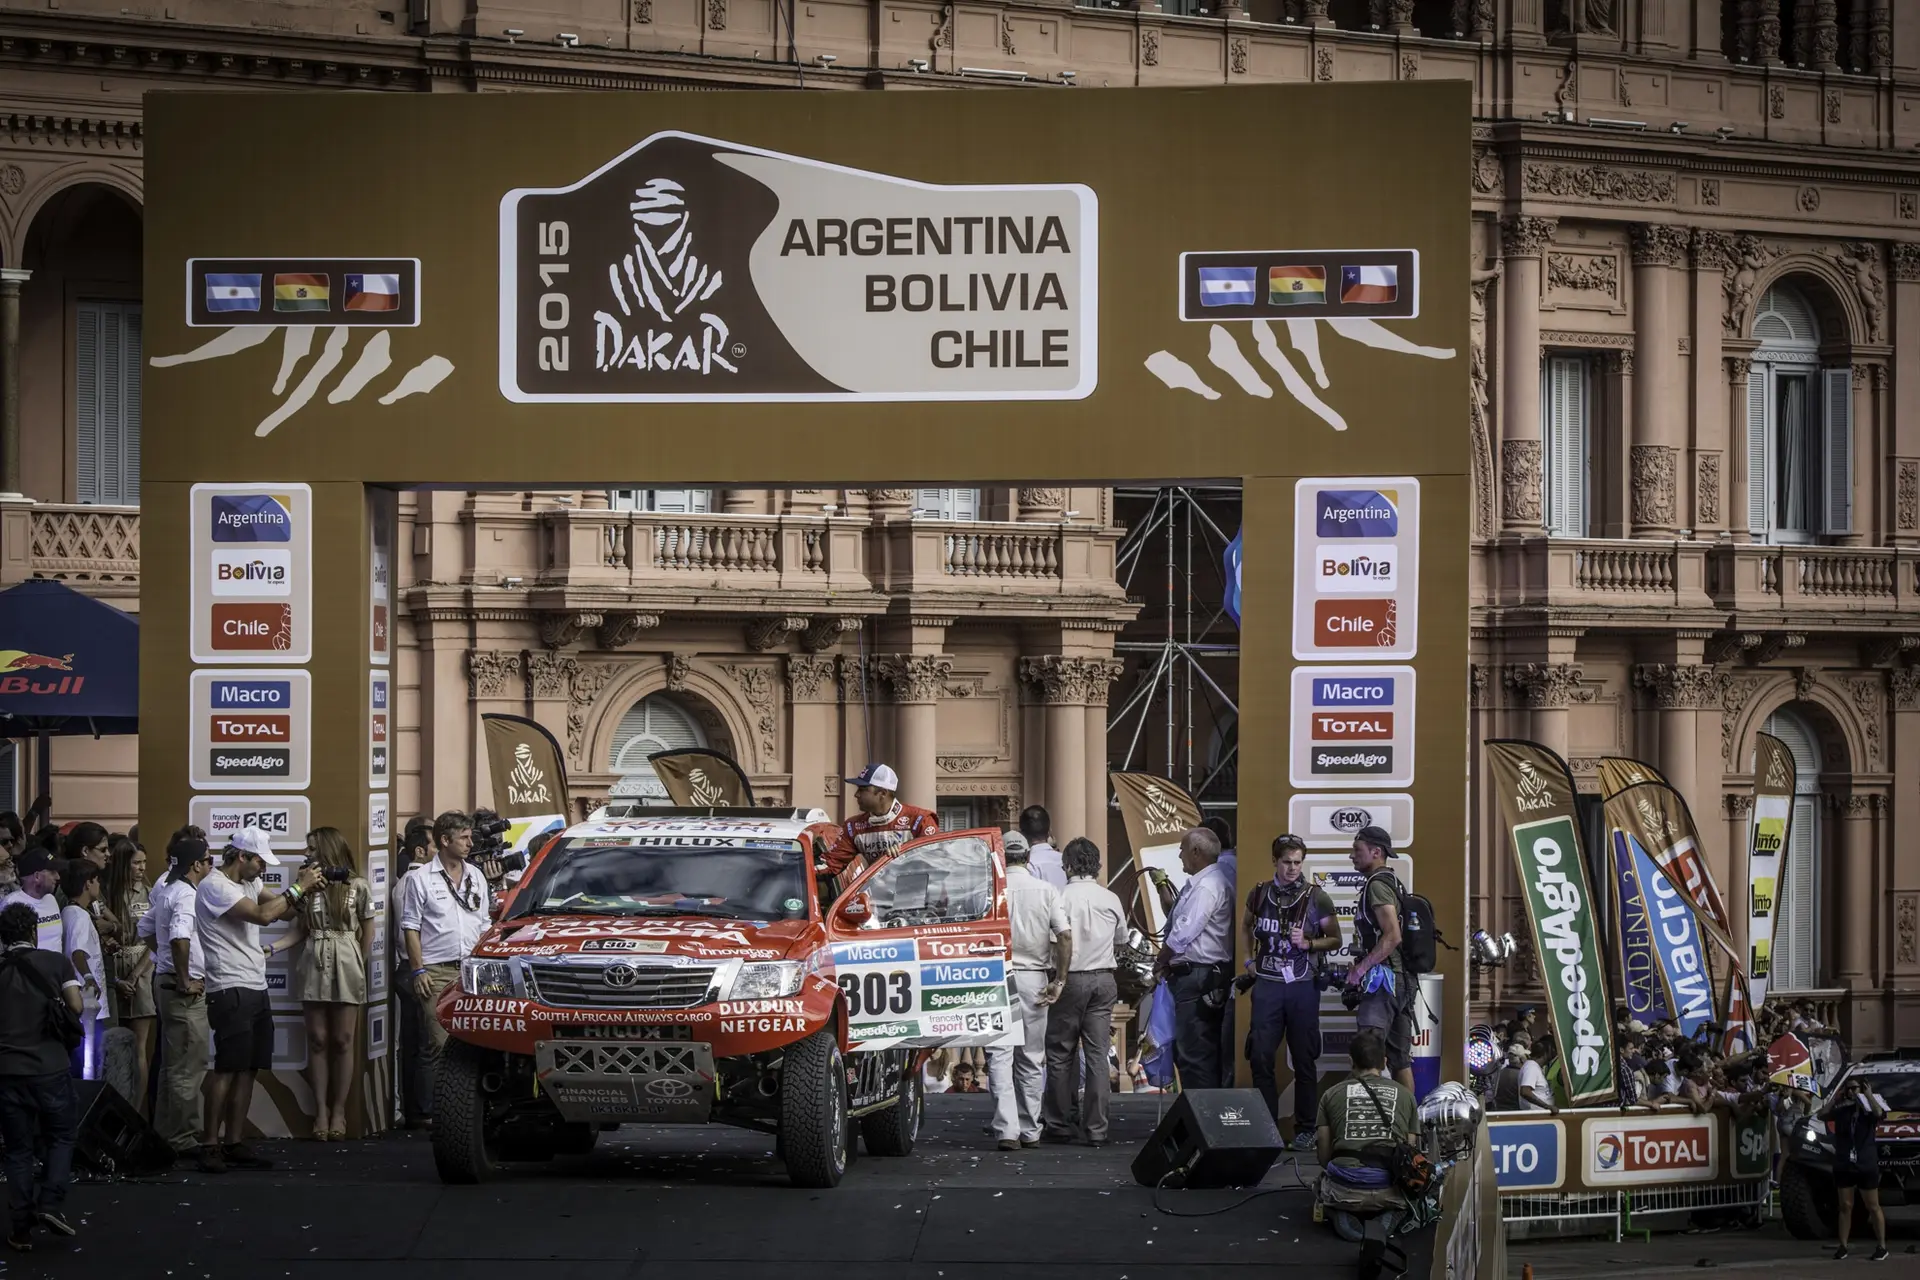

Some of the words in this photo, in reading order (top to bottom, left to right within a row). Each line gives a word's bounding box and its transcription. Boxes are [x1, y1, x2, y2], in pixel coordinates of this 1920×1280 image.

[780, 216, 1071, 256] ARGENTINA
[539, 221, 570, 371] 2015
[866, 273, 1068, 312] BOLIVIA
[594, 310, 738, 375] DAKAR
[931, 330, 1068, 368] CHILE
[218, 511, 284, 527] Argentina
[1323, 506, 1391, 523] Argentina
[218, 561, 285, 580] Bolivia
[1322, 556, 1391, 577] Bolivia
[223, 620, 270, 635] Chile
[1327, 616, 1374, 632] Chile
[0, 677, 85, 694] Bull
[1322, 683, 1384, 699] Macro
[220, 686, 280, 702] Macro
[217, 720, 284, 736] TOTAL
[1318, 719, 1387, 733] TOTAL
[216, 755, 284, 769] SpeedAgro
[1317, 753, 1387, 767] SpeedAgro
[508, 784, 551, 805] DAKAR
[1516, 791, 1556, 812] DAKAR
[1145, 815, 1187, 836] DAKAR
[1340, 812, 1362, 823] FOX
[212, 821, 240, 831] sport
[640, 837, 735, 847] HILUX
[1757, 834, 1781, 850] info
[531, 920, 745, 930] IMPERIAL
[528, 926, 752, 945] TOYOTA
[493, 943, 568, 954] innovation
[604, 941, 638, 949] 303
[698, 947, 780, 957] innovation
[1626, 893, 1650, 1013] CADENA
[1652, 870, 1711, 1020] Macro
[848, 946, 897, 961] Macro
[1533, 837, 1604, 1077] SpeedAgro
[936, 966, 990, 982] Macro
[837, 969, 912, 1018] 303
[930, 991, 998, 1006] SpeedAgro
[454, 999, 529, 1014] DUXBURY
[719, 1001, 805, 1015] DUXBURY
[451, 1016, 528, 1032] NETGEAR
[531, 1009, 570, 1022] SOUTH
[572, 1010, 622, 1022] AFRICAN
[624, 1011, 673, 1023] AIRWAYS
[675, 1012, 712, 1023] CARGO
[929, 1013, 963, 1023] francetv
[720, 1018, 806, 1033] NETGEAR
[848, 1022, 908, 1039] SpeedAgro
[932, 1021, 964, 1034] sport
[1411, 1029, 1430, 1046] ull
[558, 1088, 627, 1096] FINANCIAL
[560, 1095, 629, 1104] SERVICES
[1628, 1135, 1706, 1165] TOTAL
